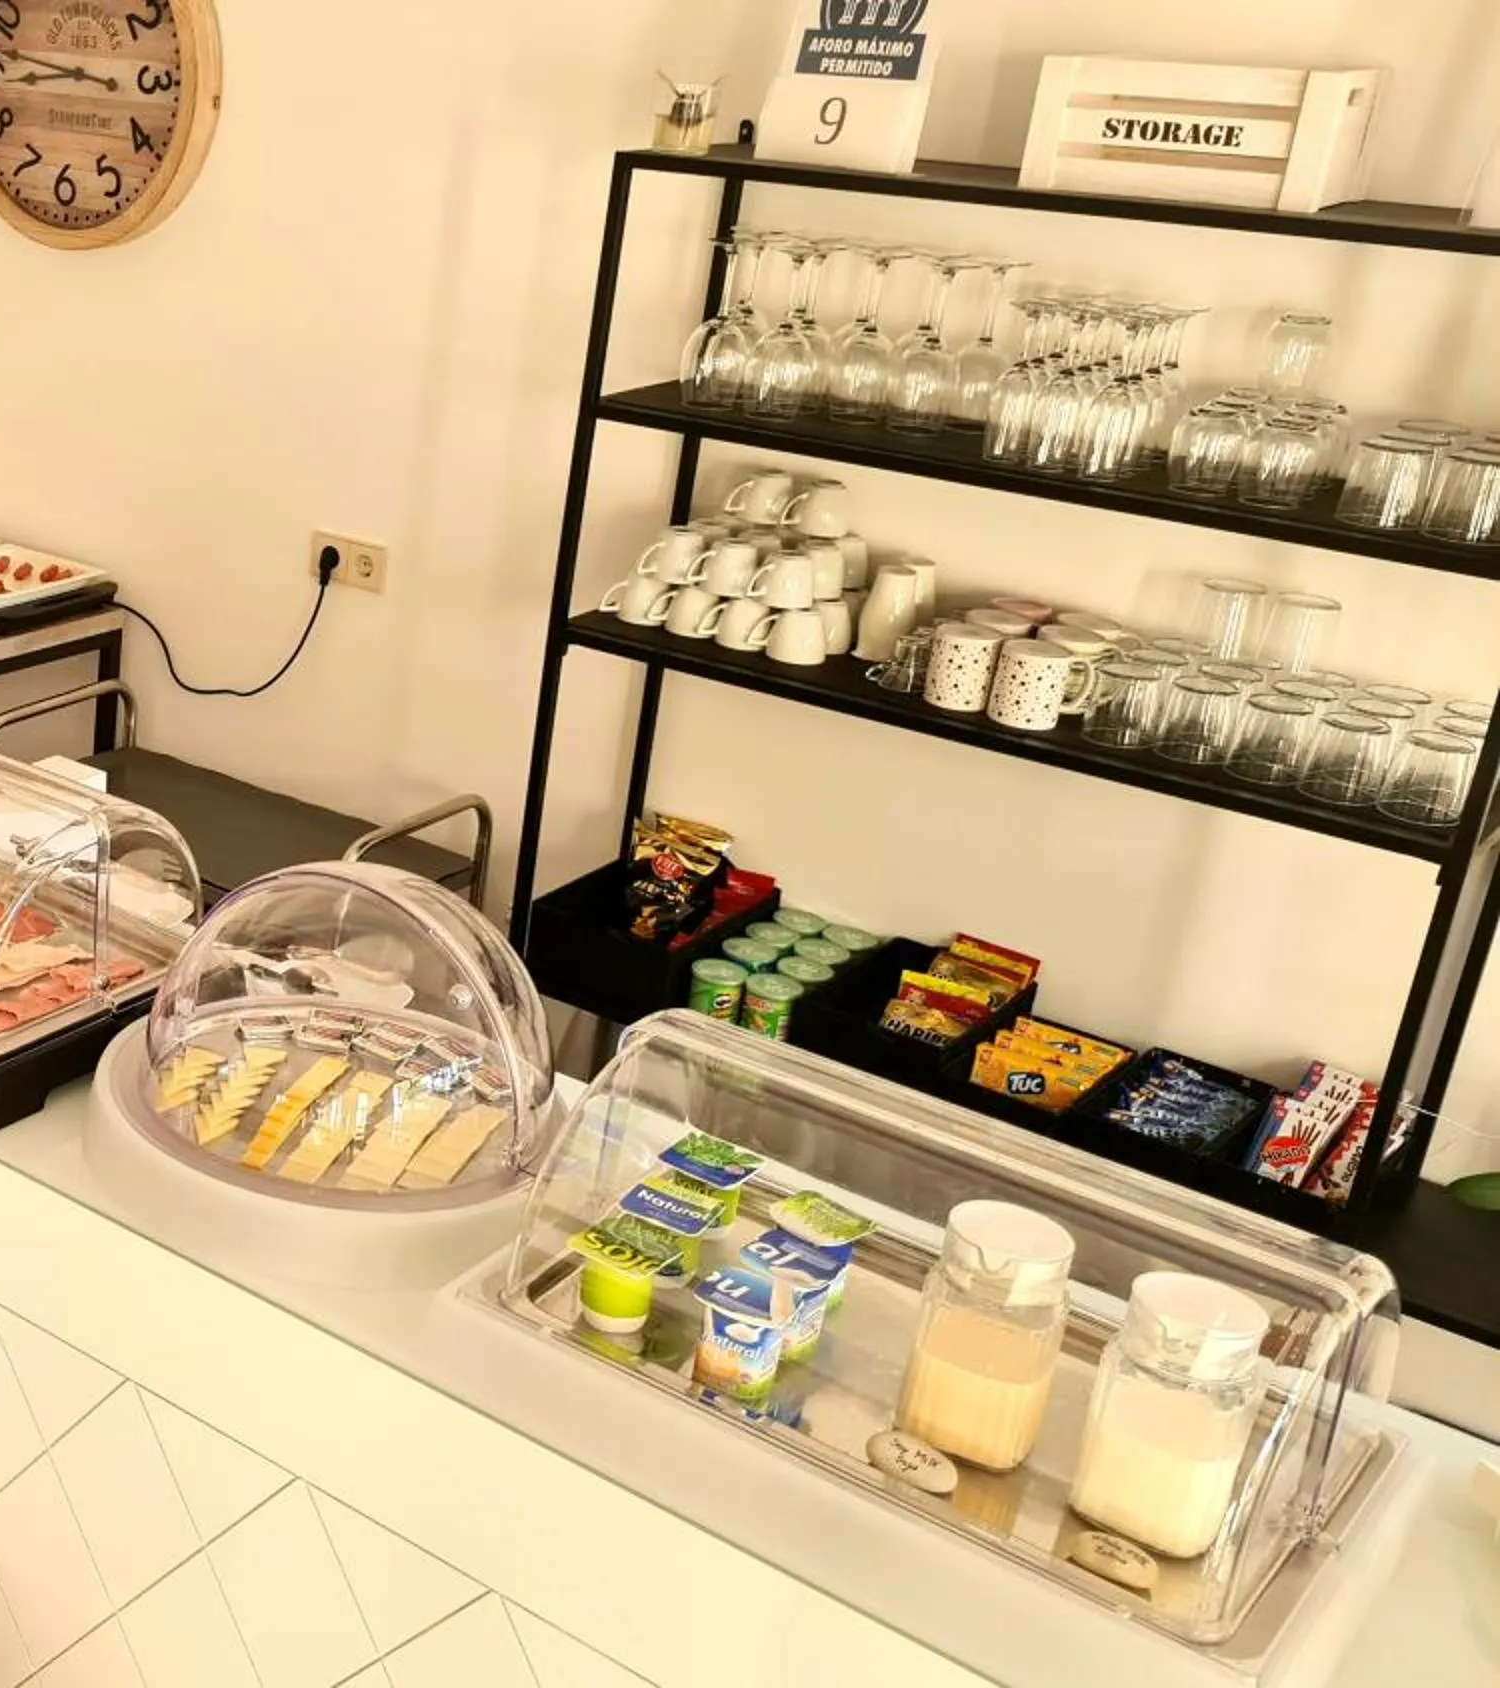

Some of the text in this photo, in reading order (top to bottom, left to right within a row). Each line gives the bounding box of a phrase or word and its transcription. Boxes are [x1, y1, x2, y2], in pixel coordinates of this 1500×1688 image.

[126, 0, 163, 40] 2
[808, 35, 915, 58] AFORO MÁXIMO
[137, 65, 173, 95] 3
[820, 57, 893, 76] PERMITIDO
[129, 116, 155, 154] 4
[814, 97, 848, 145] 9
[1101, 116, 1244, 149] STORAGE
[13, 143, 43, 177] 7
[96, 154, 121, 198] 5
[54, 164, 76, 206] 6
[1010, 1074, 1042, 1093] TUC
[637, 1189, 711, 1221] Natural
